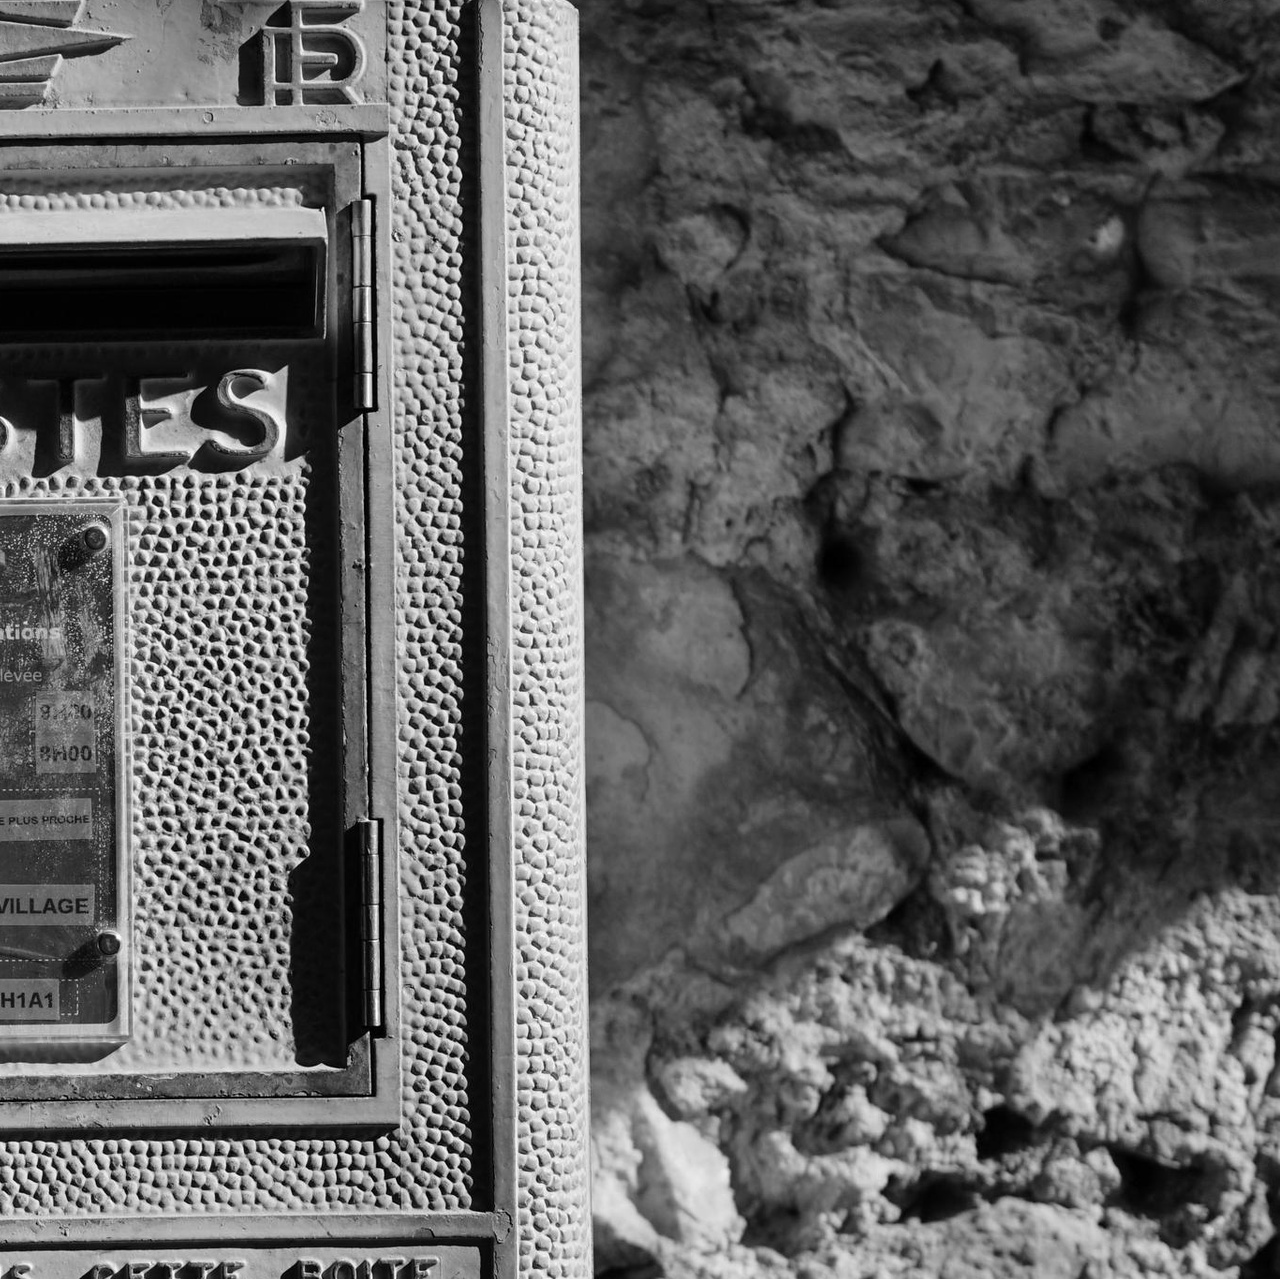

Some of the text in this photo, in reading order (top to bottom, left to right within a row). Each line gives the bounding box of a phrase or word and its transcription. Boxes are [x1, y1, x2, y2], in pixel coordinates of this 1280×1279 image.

[0, 667, 43, 683] levée
[39, 745, 93, 762] 8H00
[8, 816, 39, 826] PLUS
[42, 814, 90, 825] PROCHE
